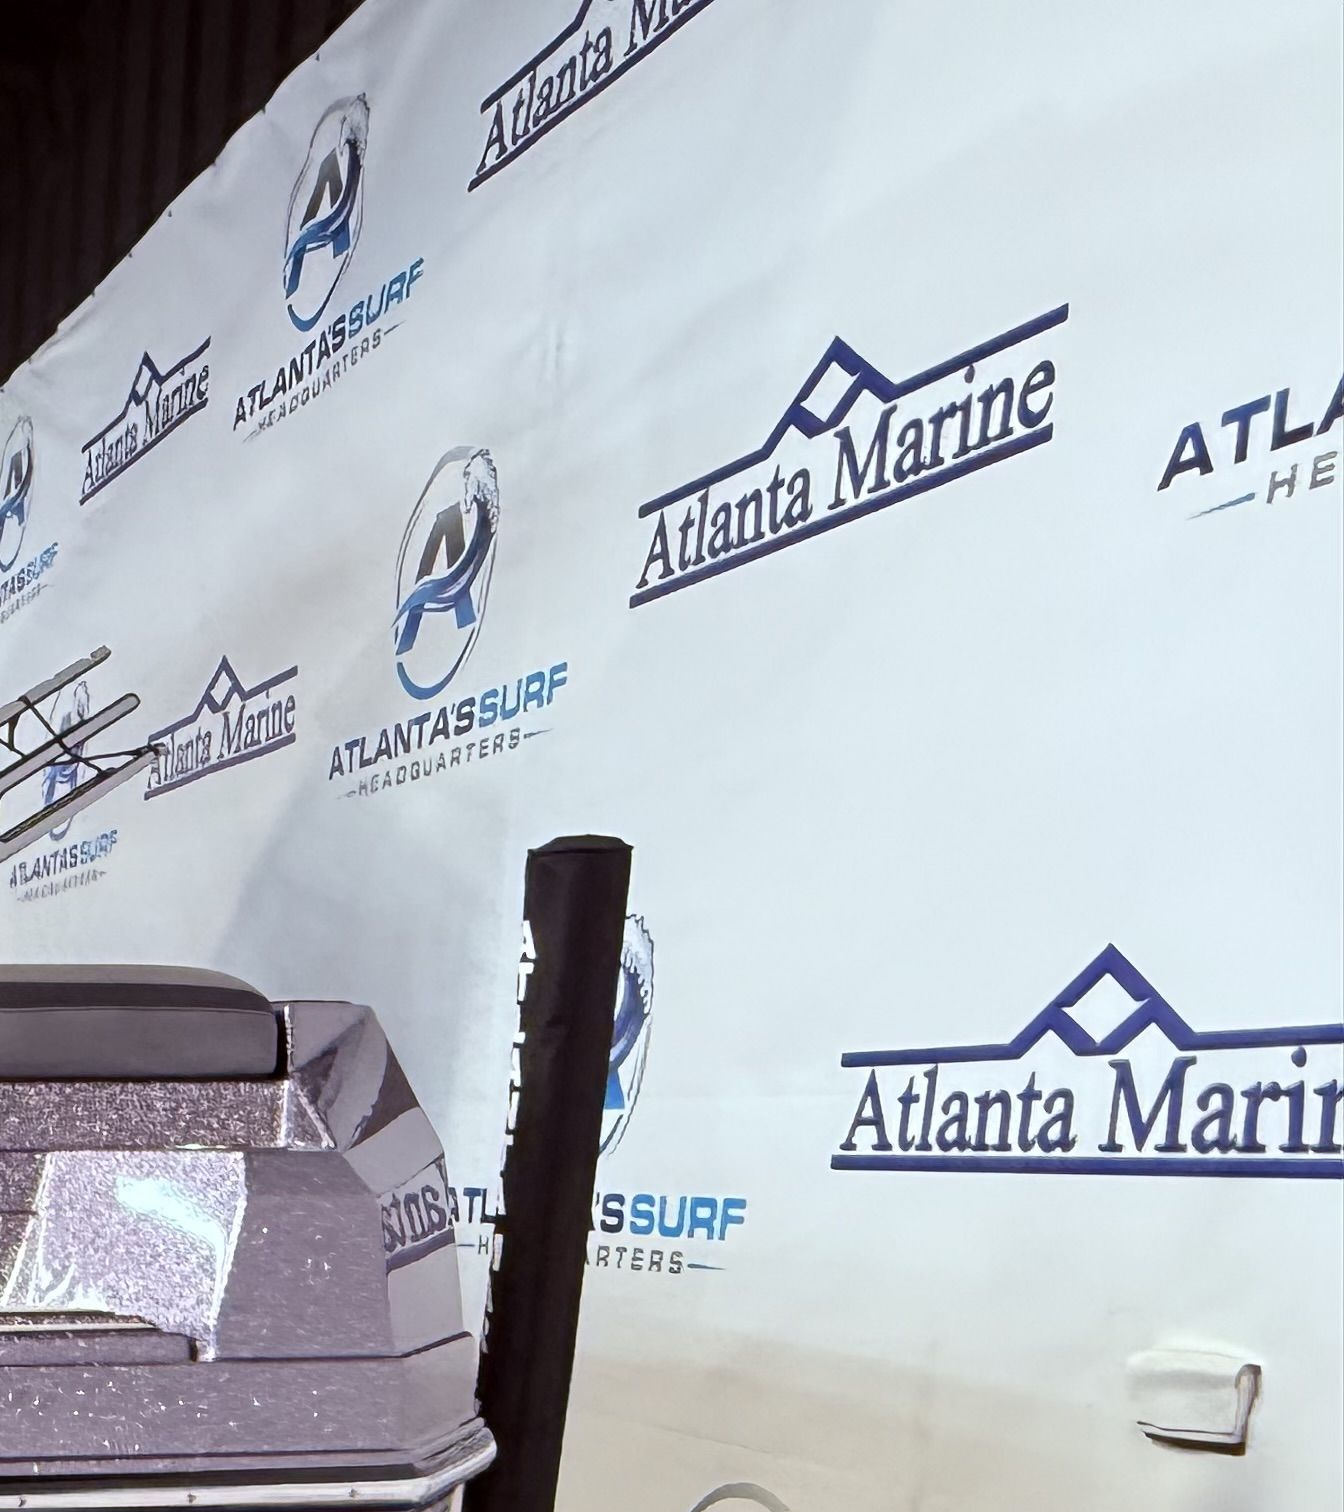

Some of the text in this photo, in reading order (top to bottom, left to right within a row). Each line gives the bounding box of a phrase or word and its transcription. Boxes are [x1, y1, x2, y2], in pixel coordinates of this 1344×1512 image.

[476, 27, 612, 175] Atlanta
[143, 364, 209, 447] Marine
[635, 359, 1056, 589] Atlanta Marine
[217, 690, 296, 760] Marine
[357, 727, 521, 798] HEADQUARTERS
[839, 1063, 1078, 1153] Atlanta
[628, 1193, 748, 1241] SURF
